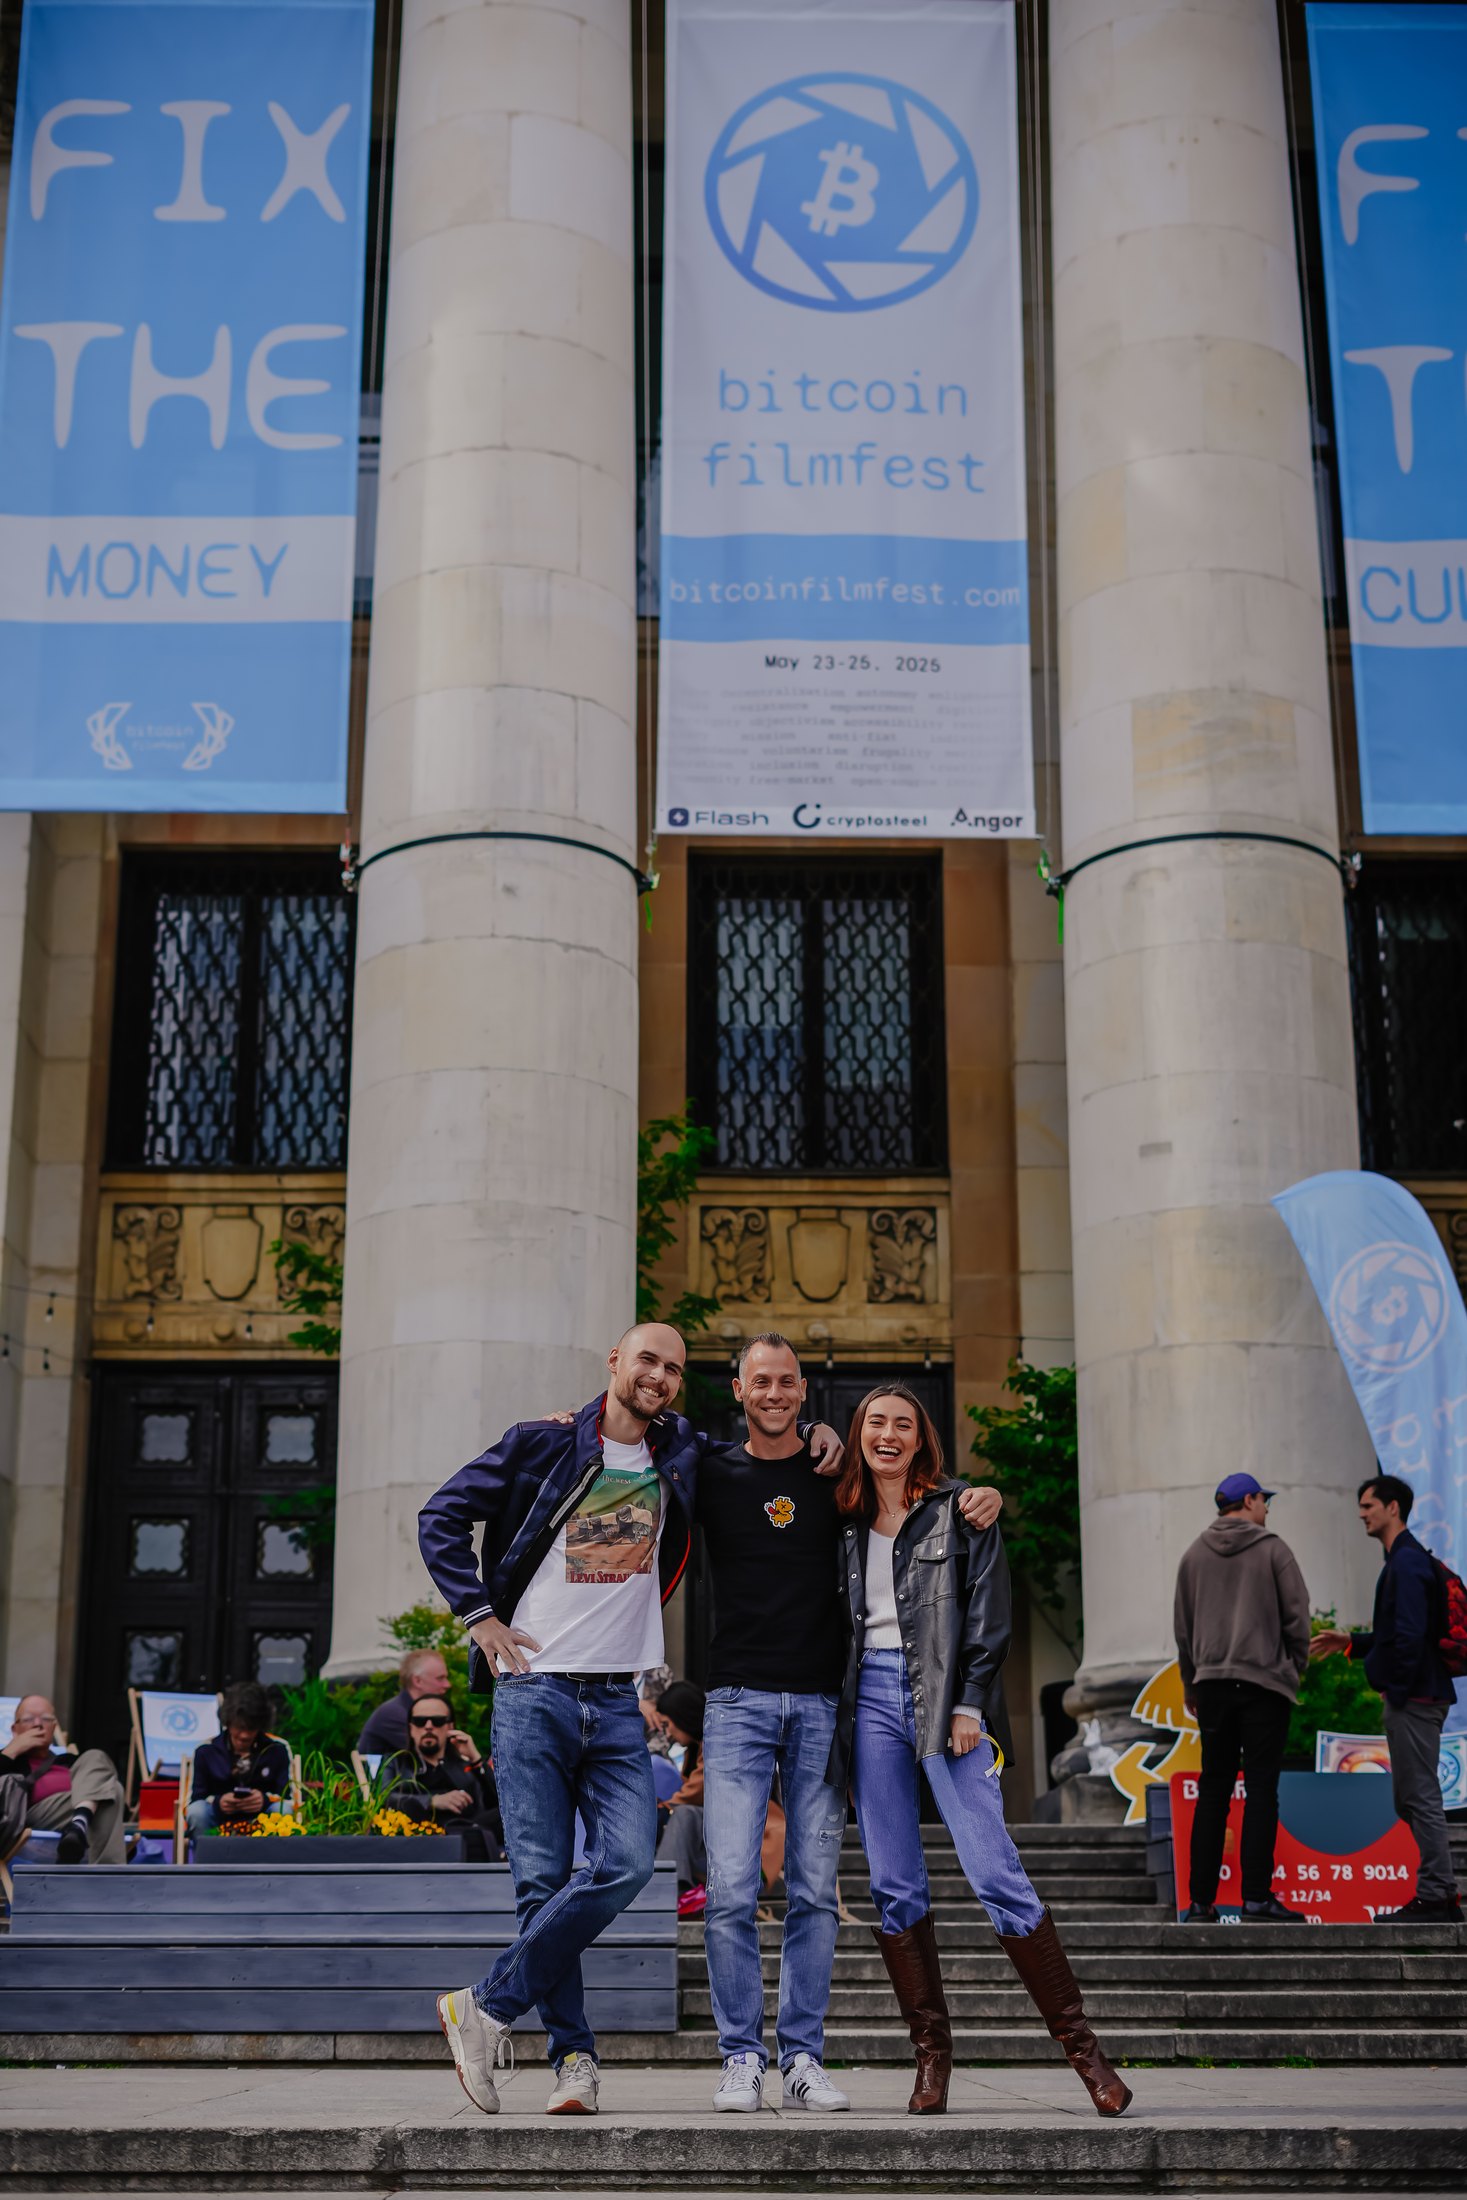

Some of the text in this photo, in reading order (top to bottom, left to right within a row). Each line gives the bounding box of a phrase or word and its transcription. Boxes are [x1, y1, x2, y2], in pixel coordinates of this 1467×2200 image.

[30, 98, 352, 223] FIX
[14, 321, 349, 451] THE
[719, 368, 968, 417] bitcoin
[703, 442, 986, 493] filmfest
[47, 541, 290, 600] MONEY
[669, 576, 1021, 607] bitcoinfilmfest.com
[765, 655, 800, 672] May
[895, 656, 942, 673] 2025
[695, 807, 1024, 832] Flash cryptosteel Angor
[570, 1570, 595, 1583] LEVI
[1297, 1864, 1320, 1880] 56
[1330, 1864, 1353, 1880] 78
[1363, 1864, 1408, 1880] 9014
[1291, 1889, 1332, 1903] 12/34
